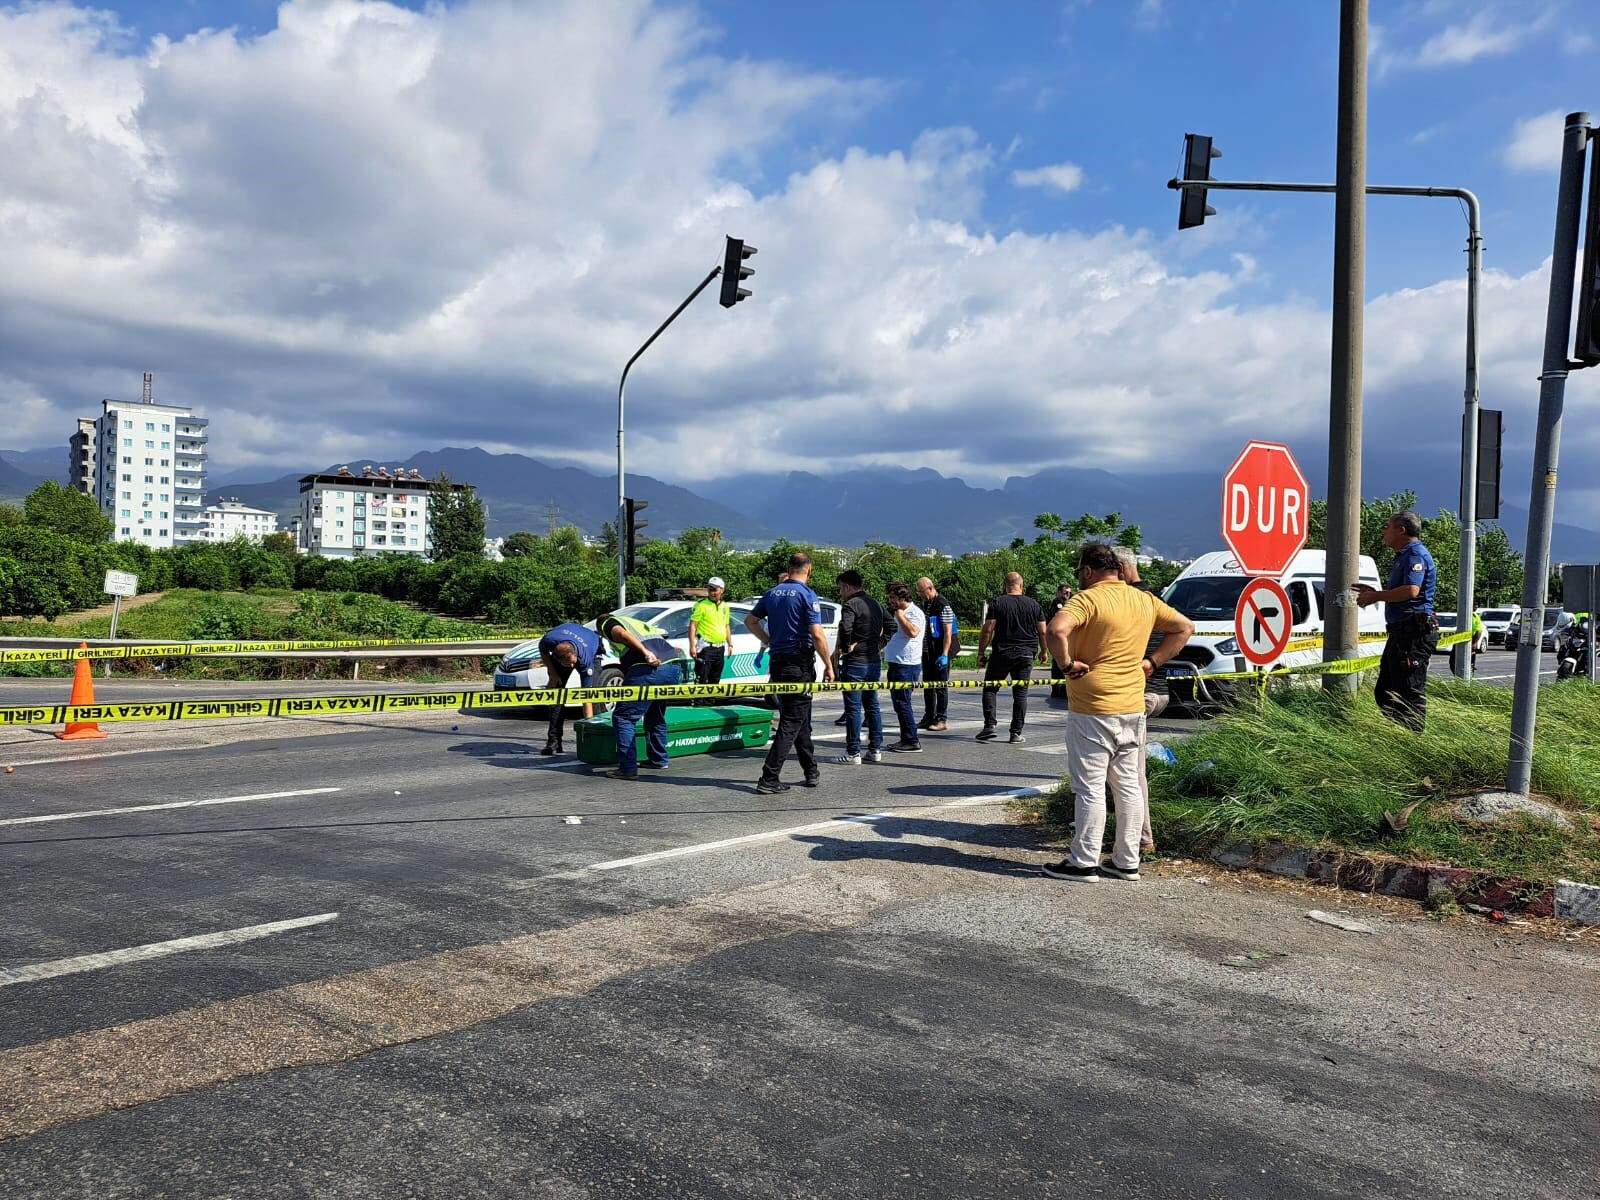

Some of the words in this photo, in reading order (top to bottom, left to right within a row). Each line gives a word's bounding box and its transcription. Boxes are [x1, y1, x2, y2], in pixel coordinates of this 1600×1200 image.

[1231, 483, 1300, 535] DUR
[769, 588, 798, 598] POLİS
[563, 628, 588, 648] POLİS
[6, 652, 36, 661] KAZA
[38, 650, 63, 660] YERİ
[77, 648, 122, 659] GİRİLMEZ
[133, 647, 160, 656] KAZA
[160, 646, 182, 656] YERİ
[194, 644, 233, 654] GİRİLMEZ
[243, 644, 264, 652] KAZA
[264, 642, 286, 651] YERİ
[517, 690, 555, 702] KAZA
[571, 688, 634, 703] GİRİLMEZ
[654, 686, 683, 699] YERİ
[688, 685, 726, 697] KAZA
[741, 683, 798, 695] GİRİLMEZ
[287, 700, 323, 714] YERİ
[327, 697, 371, 710] KAZA
[389, 695, 457, 709] GİRİLMEZ
[479, 693, 512, 707] YERİ
[74, 706, 114, 722] YERİ
[119, 704, 167, 718] KAZA
[187, 702, 262, 717] GİRİLMEZ
[675, 737, 697, 747] HATAY
